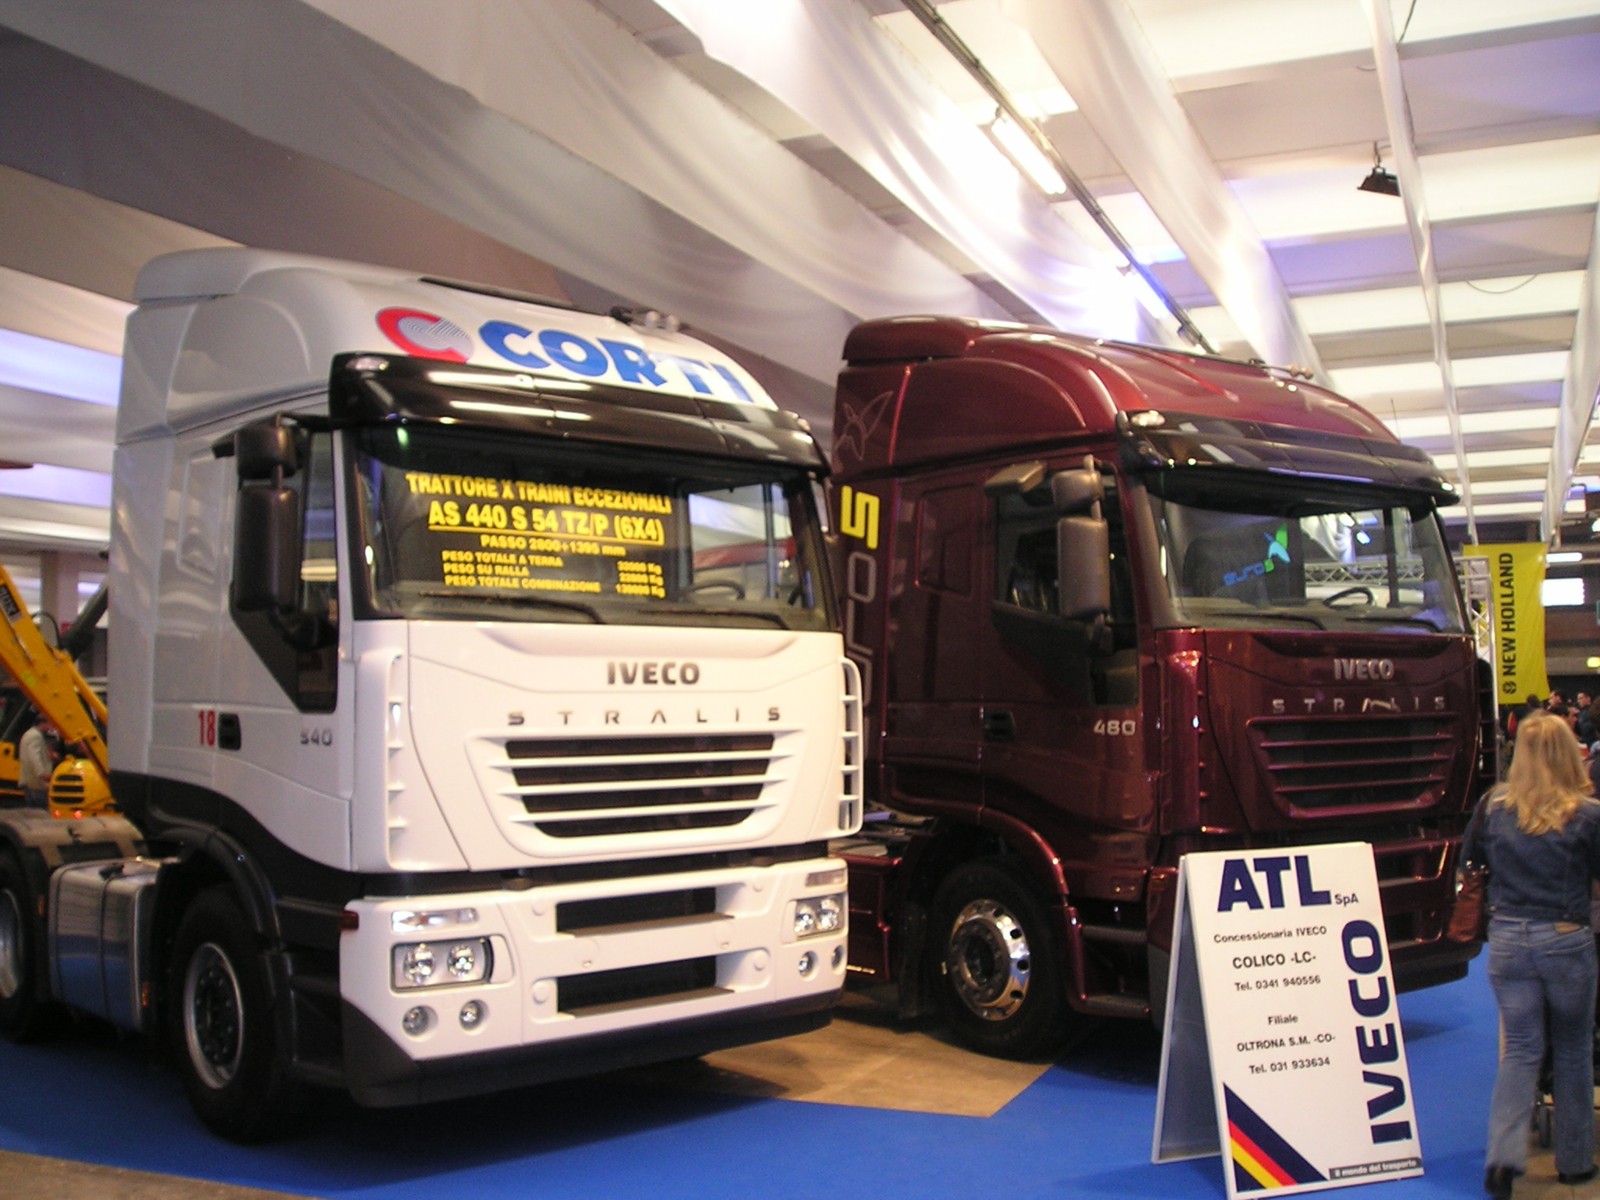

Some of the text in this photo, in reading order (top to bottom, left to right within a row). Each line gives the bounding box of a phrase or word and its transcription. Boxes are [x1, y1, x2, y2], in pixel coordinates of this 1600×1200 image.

[478, 319, 754, 403] CORTI
[406, 472, 672, 514] TRATTORE X TRAINI ECCEZIONALI
[428, 500, 664, 545] AS 440 S 54 TZ/P (6X4)
[481, 534, 527, 550] PASSO
[442, 550, 565, 567] PESO TOTALE A TERRA
[443, 562, 531, 577] PESO SU RALLA
[445, 575, 477, 587] PESO
[478, 576, 520, 589] TOTALE
[1498, 552, 1517, 677] NEW HOLLAND
[607, 661, 700, 685] IVECO
[1333, 658, 1394, 680] IVECO
[1272, 696, 1446, 714] STRALIS
[508, 706, 781, 726] STRALIS
[199, 709, 216, 748] 18
[300, 727, 333, 747] 540
[1217, 855, 1359, 912] ATL SpA
[1213, 925, 1327, 944] Concessionaria IVECO
[1232, 951, 1317, 970] COLICO -LC-
[1234, 975, 1321, 992] Tel. 0341 940556
[1267, 1015, 1299, 1026] Filiale
[1341, 919, 1413, 1145] IVECO
[1236, 1033, 1336, 1053] OLTRONA S.M. -CO-
[1249, 1057, 1331, 1075] Tel. 031 933634
